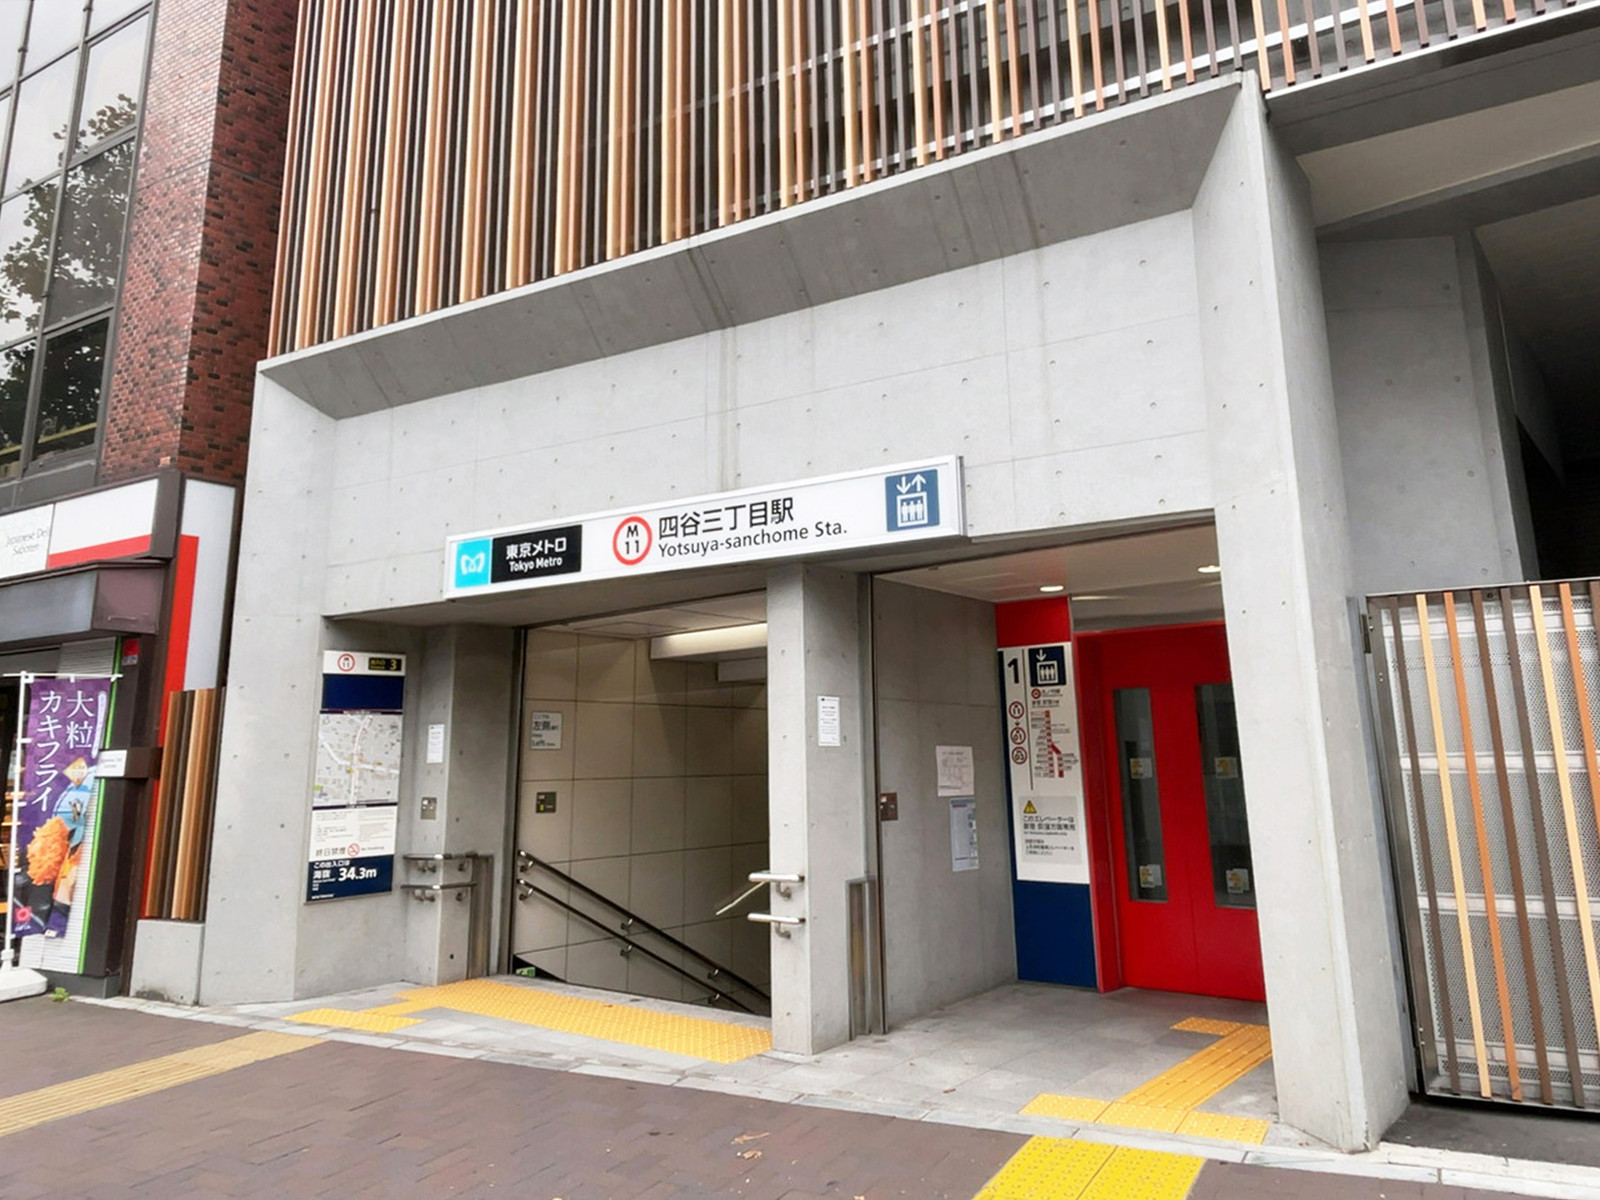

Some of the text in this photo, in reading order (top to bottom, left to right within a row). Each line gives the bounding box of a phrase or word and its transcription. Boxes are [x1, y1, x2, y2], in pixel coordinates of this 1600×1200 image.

[659, 497, 794, 540] 四谷三丁目駅
[626, 524, 639, 538] M
[658, 521, 848, 558] Yotsuya-sanchome Sta.
[505, 536, 567, 560] 東京メトロ
[624, 540, 640, 555] 11
[509, 556, 563, 573] Tokyo Metro
[389, 659, 398, 671] 3
[1007, 657, 1020, 684] 1
[66, 690, 95, 750] 大粒
[32, 690, 62, 812] カキフライ
[338, 866, 378, 882] 34.3m
